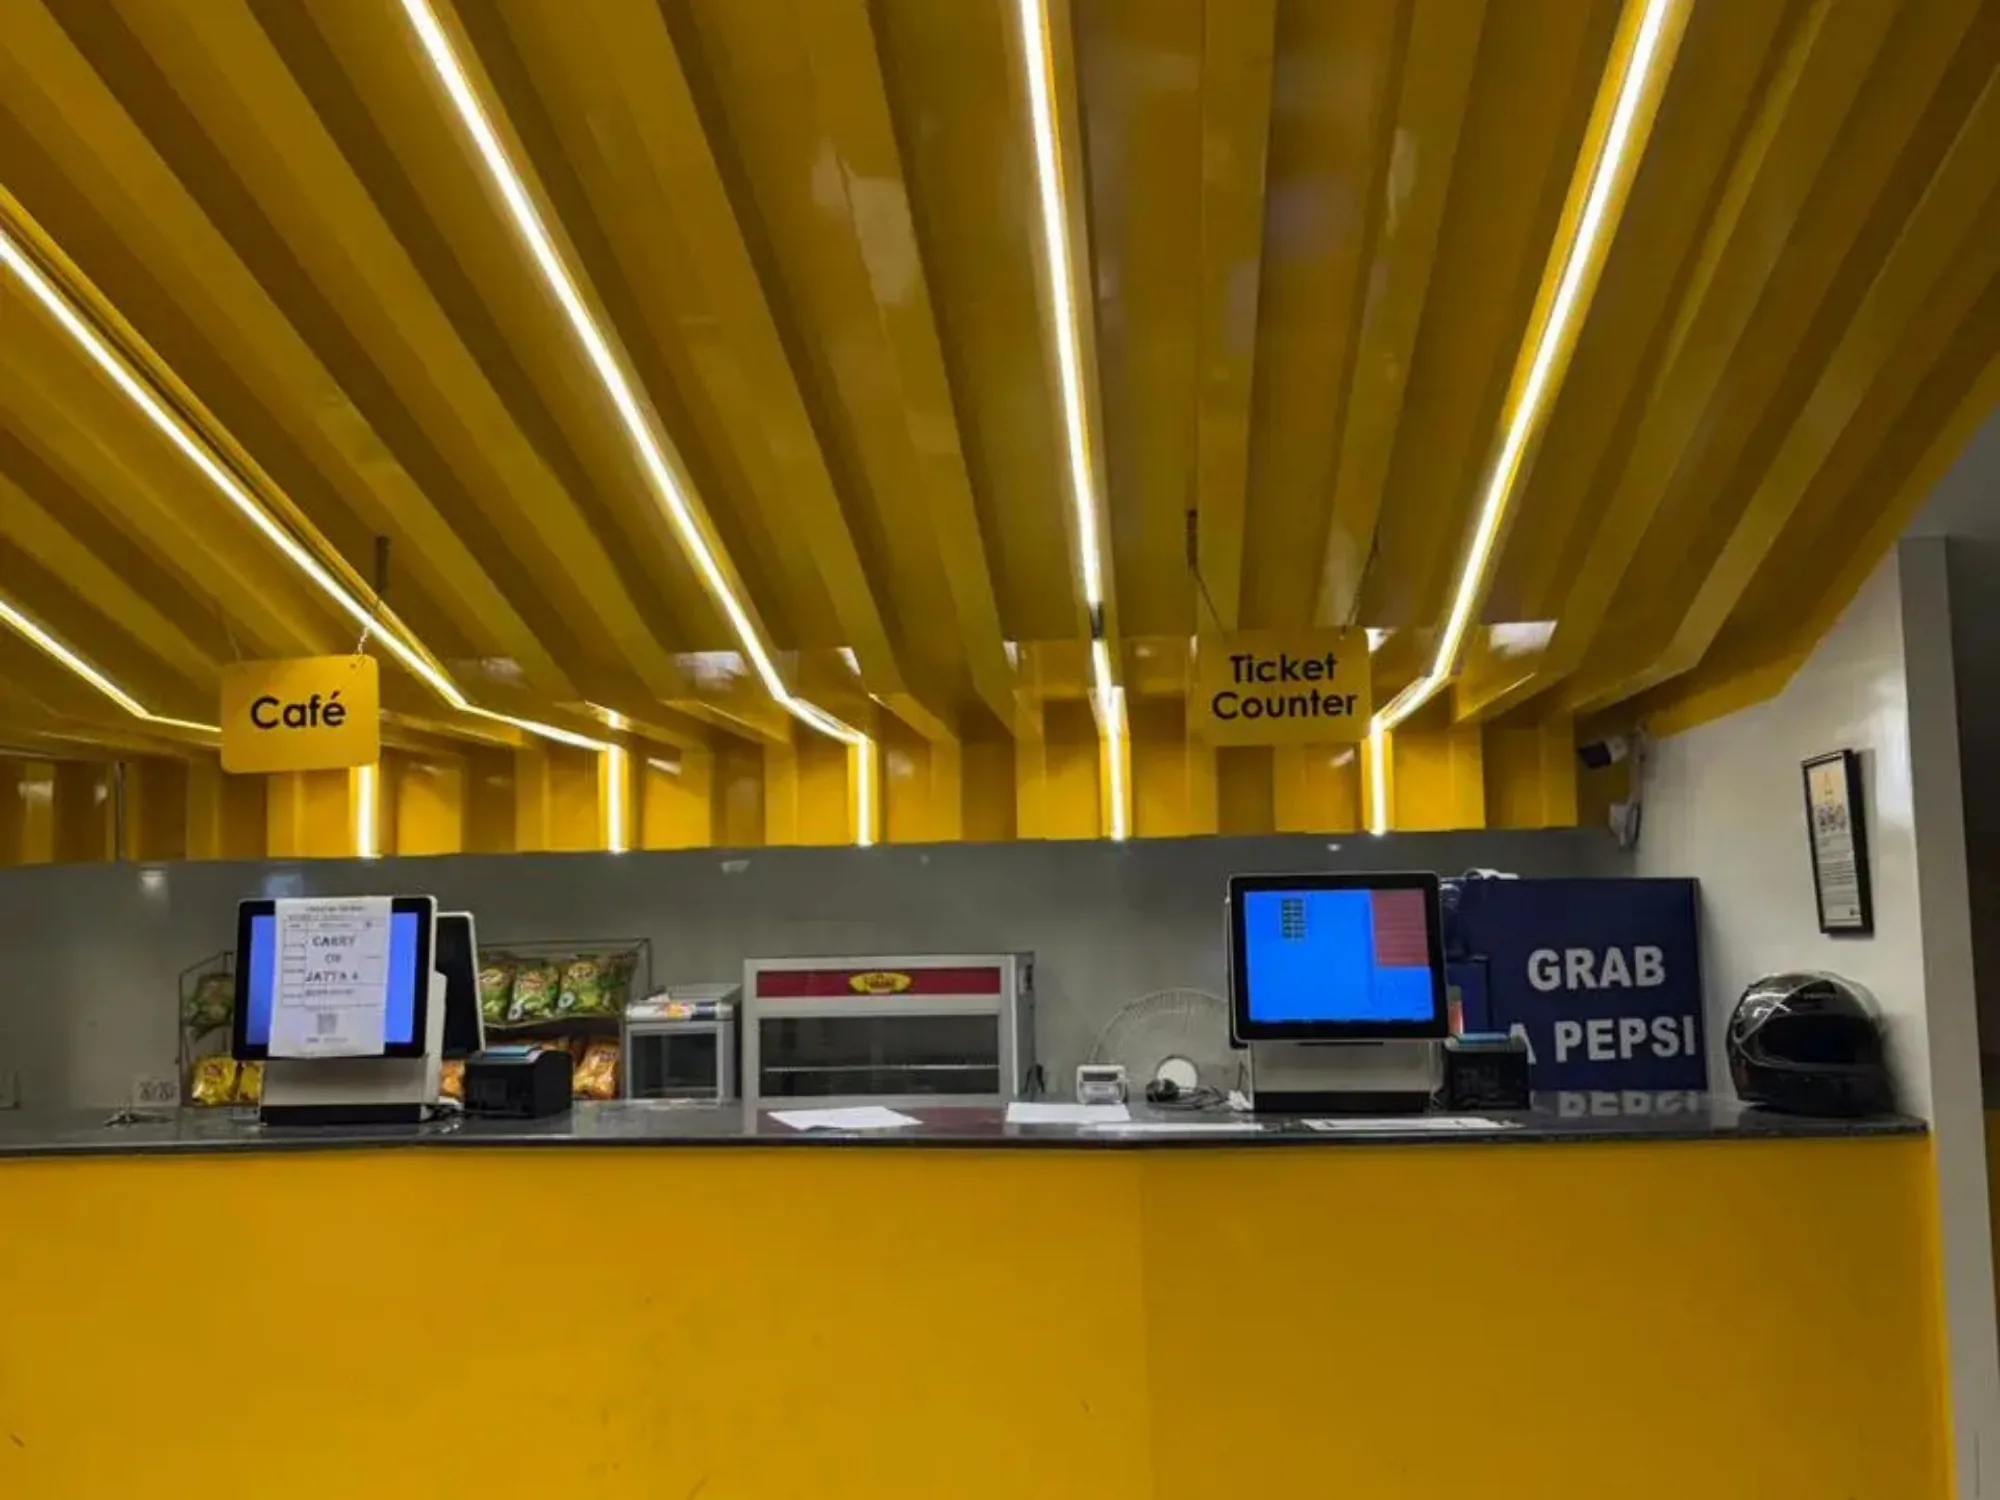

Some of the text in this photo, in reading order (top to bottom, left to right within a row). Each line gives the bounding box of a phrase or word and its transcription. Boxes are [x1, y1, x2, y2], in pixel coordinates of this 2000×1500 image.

[1230, 652, 1338, 683] Ticket
[250, 690, 346, 730] Café
[1212, 688, 1358, 720] Counter
[312, 935, 356, 947] CARRY
[1527, 945, 1666, 991] GRAB
[1554, 1015, 1696, 1063] PEPSI
